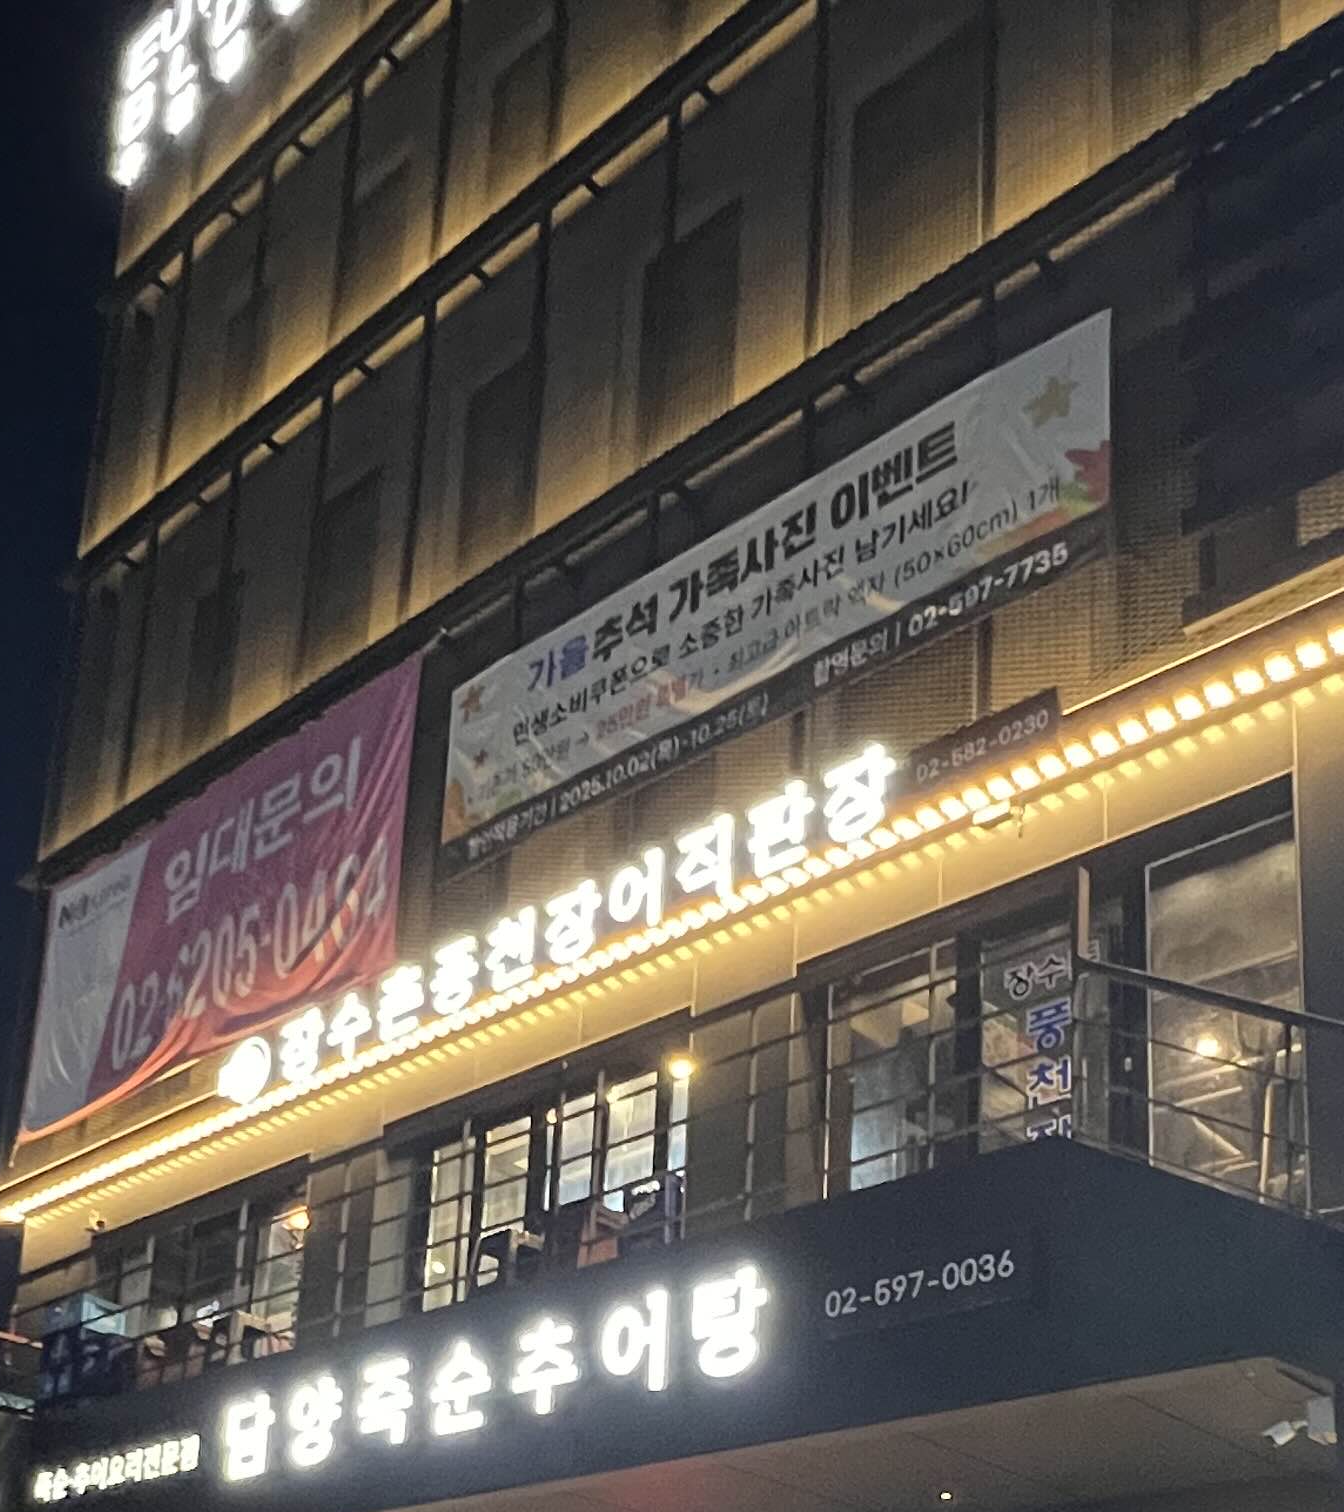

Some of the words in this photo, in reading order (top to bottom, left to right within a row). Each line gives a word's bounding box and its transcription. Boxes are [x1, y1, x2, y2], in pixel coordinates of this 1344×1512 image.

[666, 497, 817, 628] 가족사진
[828, 414, 960, 539] 이벤트
[678, 600, 744, 665] 소중한
[750, 541, 846, 626] 가족사진
[164, 737, 362, 924] 임대문의
[223, 1263, 769, 1482] 담양죽순추어탕
[823, 1249, 1016, 1319] 02-597-0036
